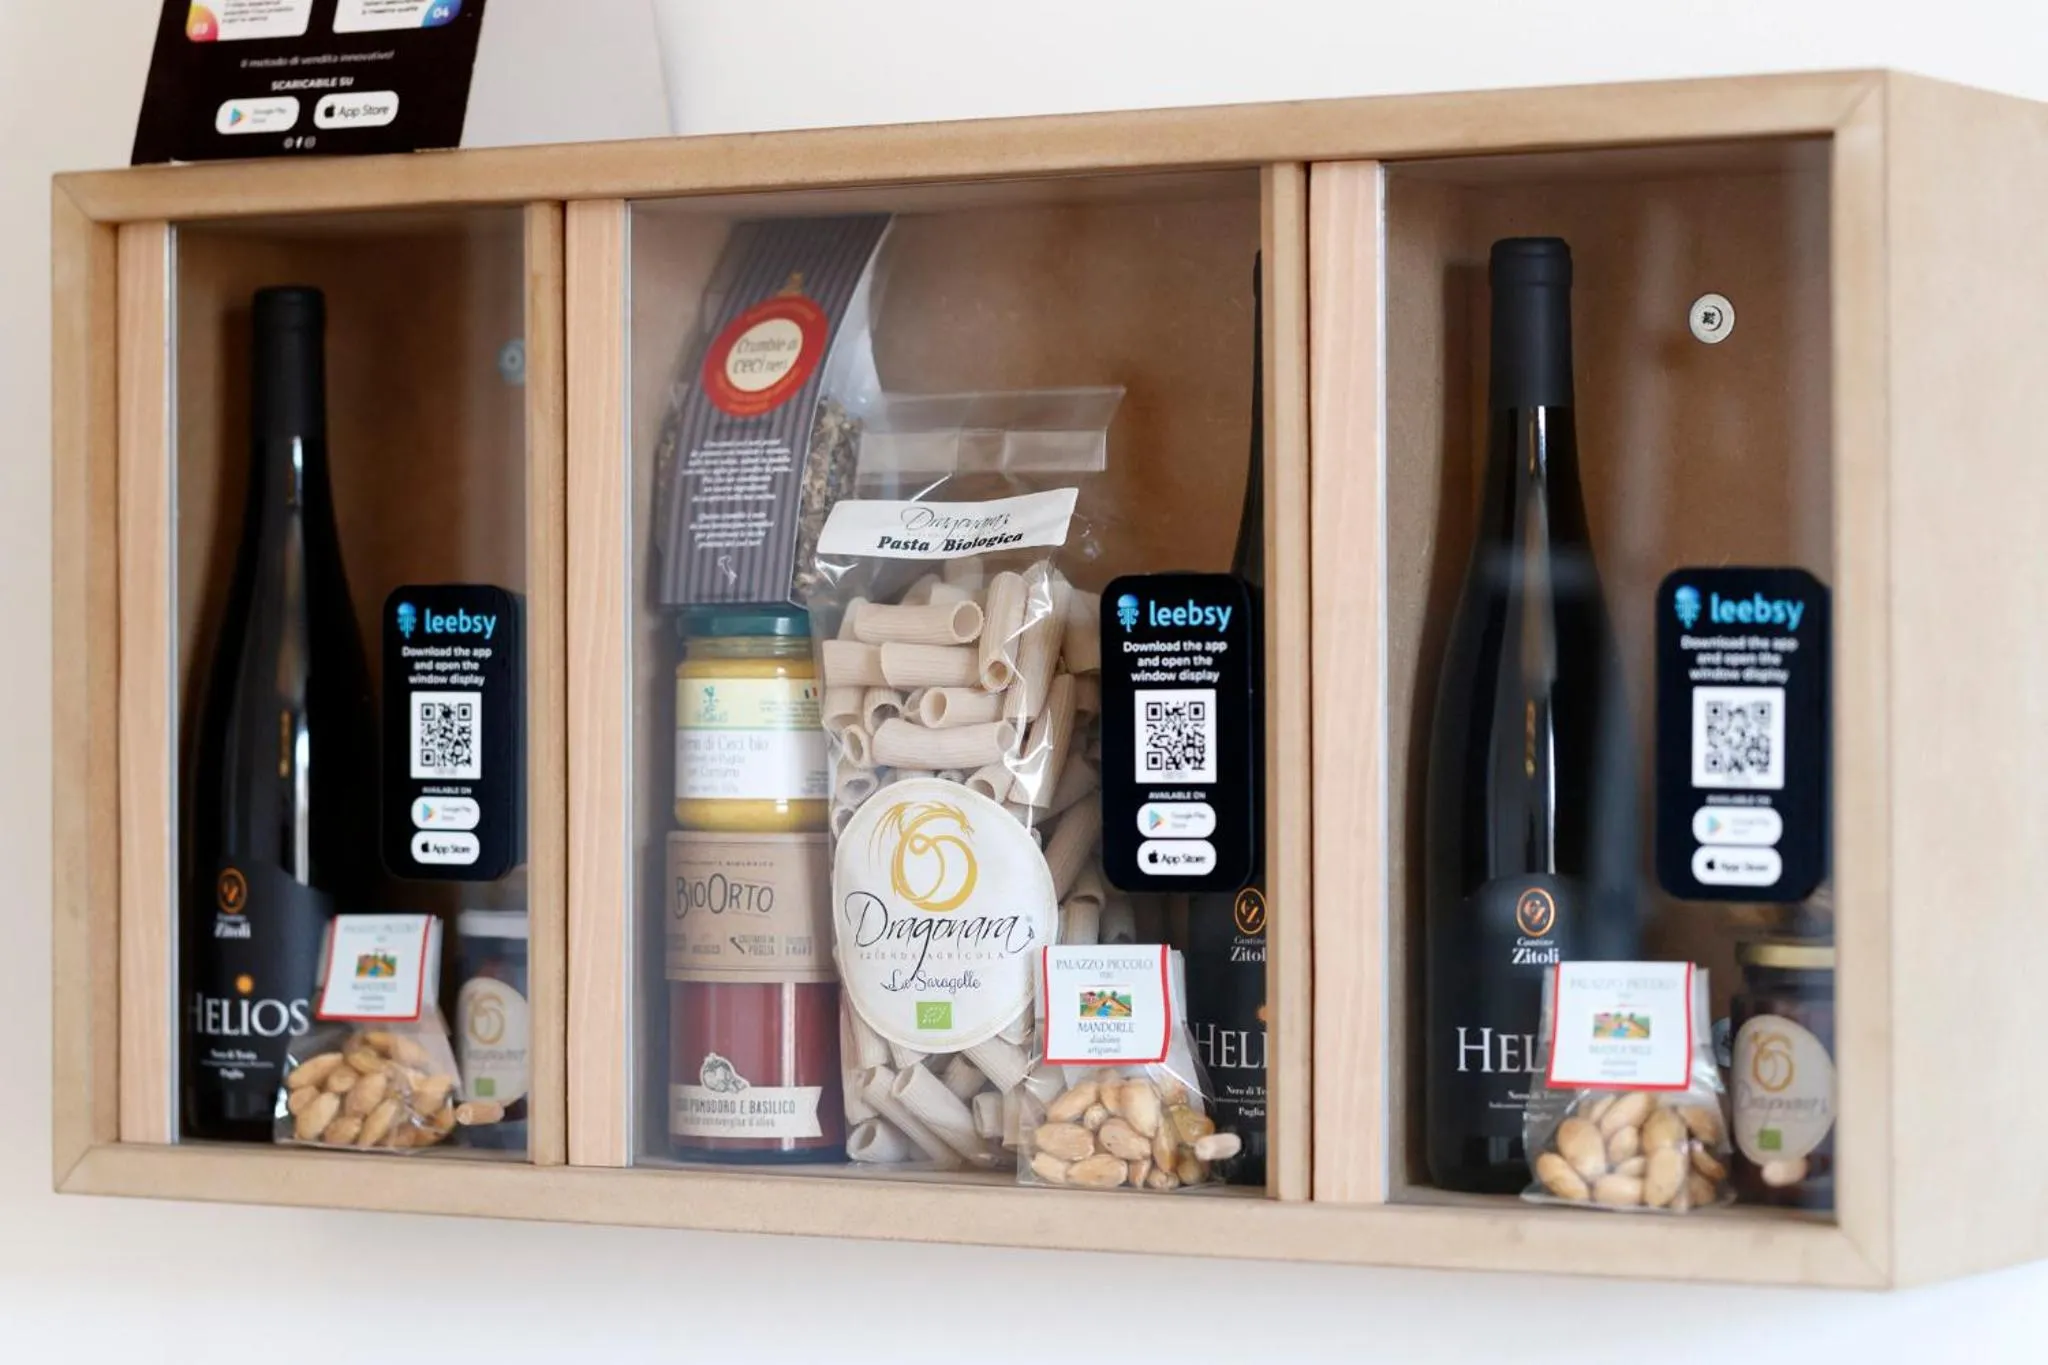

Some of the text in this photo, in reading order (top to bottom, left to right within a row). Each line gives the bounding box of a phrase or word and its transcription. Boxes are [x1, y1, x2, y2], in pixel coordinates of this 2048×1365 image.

[433, 7, 450, 19] 04
[271, 76, 354, 91] SCARICABILE SU
[338, 105, 389, 118] App Store
[877, 531, 1023, 552] Pasta Biologica
[1149, 599, 1233, 633] leebsy
[1709, 592, 1804, 632] leebsy
[424, 608, 497, 639] leebsy
[1123, 641, 1228, 656] Download the app
[1680, 635, 1747, 650] Download
[1748, 636, 1770, 650] the
[402, 645, 492, 660] Download the app
[1696, 651, 1782, 668] and open the
[413, 660, 480, 674] and open the
[1137, 655, 1213, 670] and open the
[408, 673, 485, 687] window display
[1130, 670, 1220, 684] window display
[1689, 668, 1740, 682] window
[422, 786, 459, 795] AVAILABLE
[1148, 791, 1206, 800] AVAILABLE ON
[432, 844, 471, 855] App Store
[1160, 853, 1206, 866] App Store
[844, 891, 1034, 981] Dragonara
[926, 950, 1005, 961] AGRICOLA
[1230, 946, 1266, 962] Zitol
[1512, 948, 1559, 965] Zitoli
[1056, 959, 1154, 971] PALAZZO PICCOLO
[1077, 1022, 1135, 1034] MANDORLE
[1456, 1026, 1546, 1073] HEL
[1226, 1085, 1244, 1095] Nero
[1245, 1085, 1254, 1096] di
[740, 1099, 746, 1114] E
[748, 1098, 796, 1114] BASILICO
